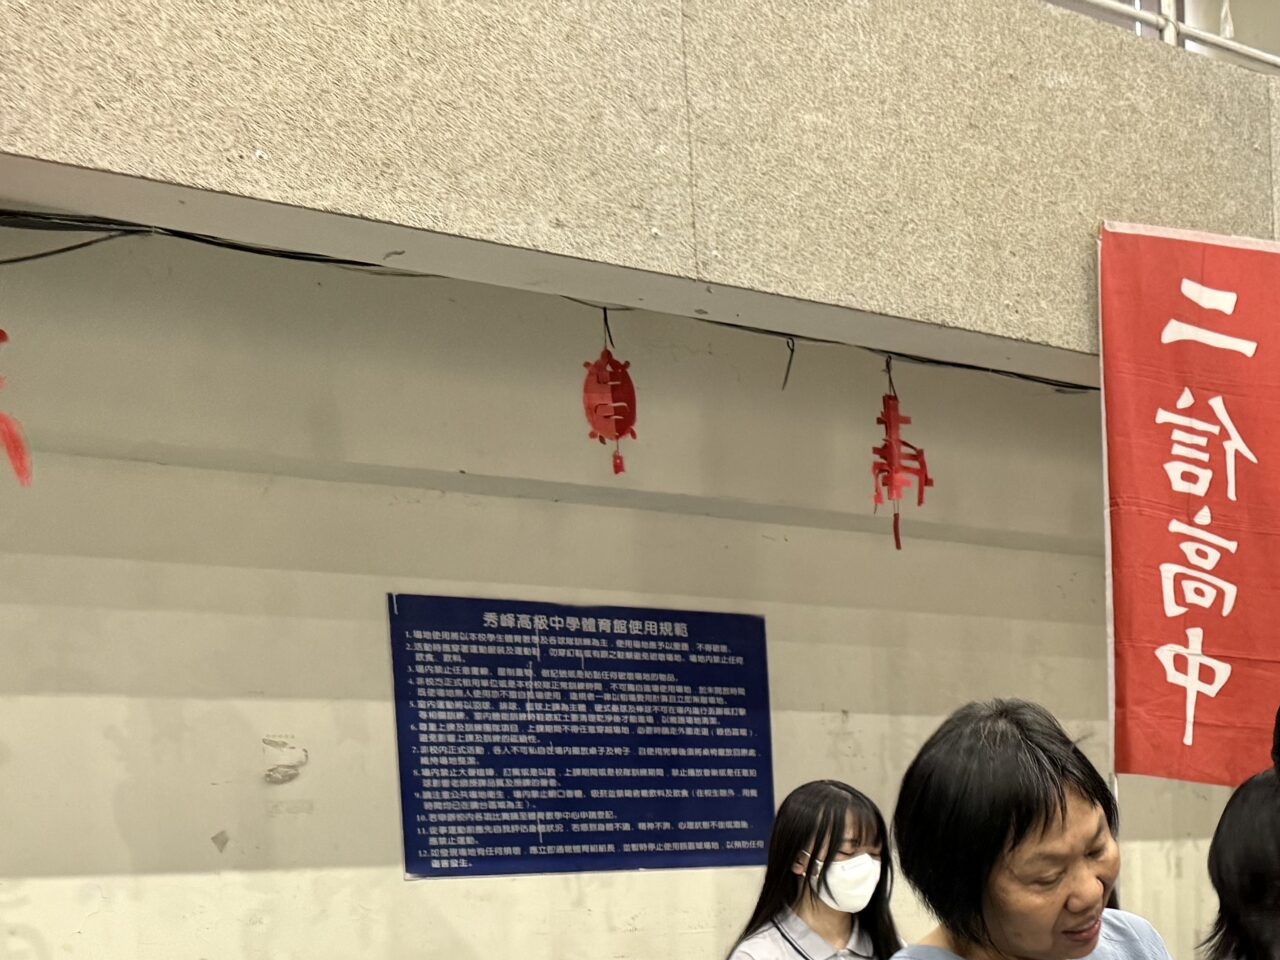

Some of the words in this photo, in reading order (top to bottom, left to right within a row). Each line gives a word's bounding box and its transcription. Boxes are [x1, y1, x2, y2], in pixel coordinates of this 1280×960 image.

[483, 612, 689, 638] 秀峰高級中學體育館使用規範
